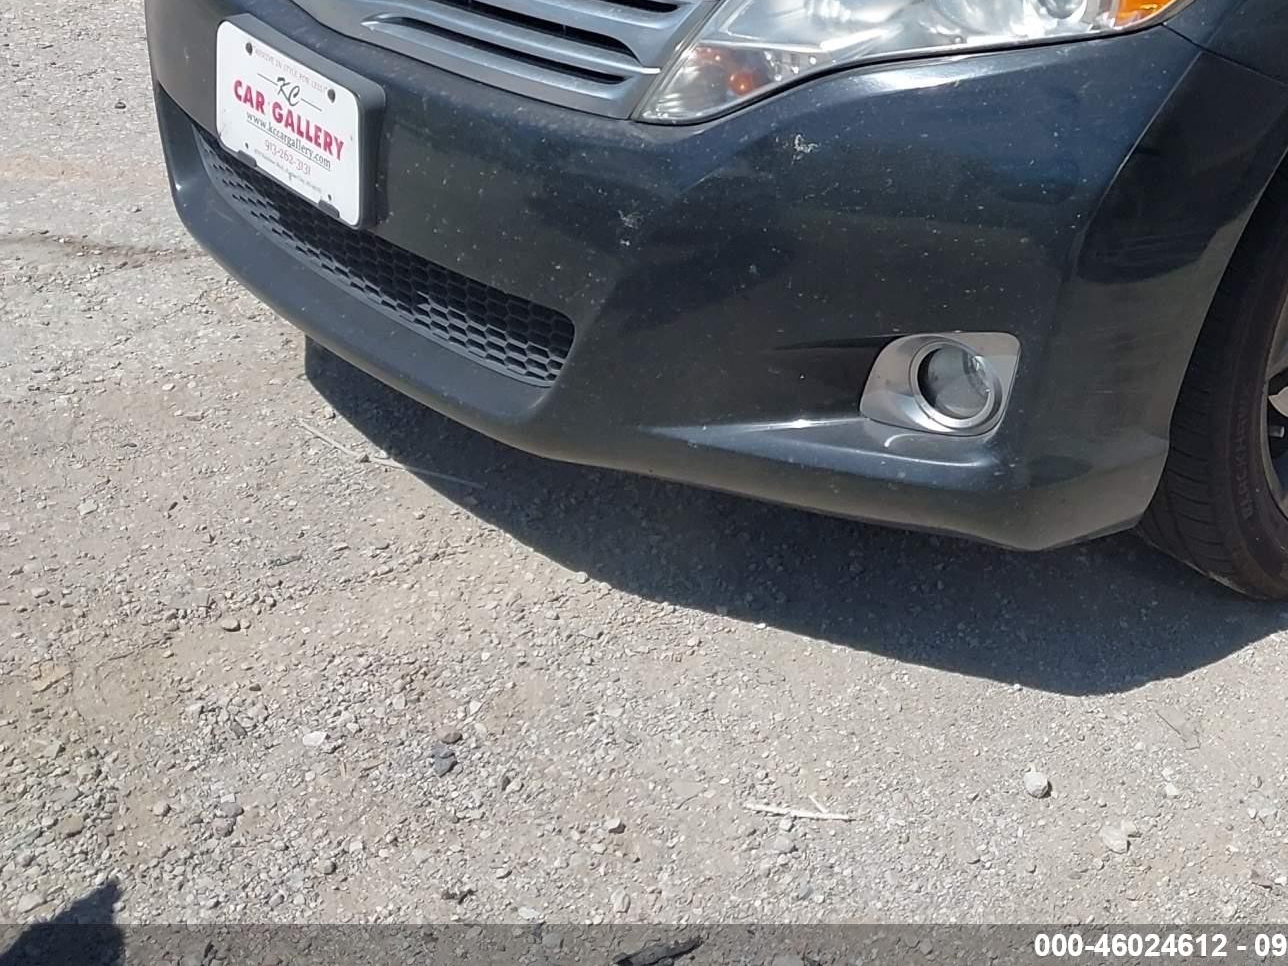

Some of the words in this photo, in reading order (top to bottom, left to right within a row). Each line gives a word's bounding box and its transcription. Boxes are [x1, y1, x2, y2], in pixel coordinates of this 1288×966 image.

[233, 79, 266, 115] CAR
[271, 102, 346, 161] GALLERY
[246, 112, 332, 169] www.kccargallery.com
[264, 139, 312, 176] 913-262-3131
